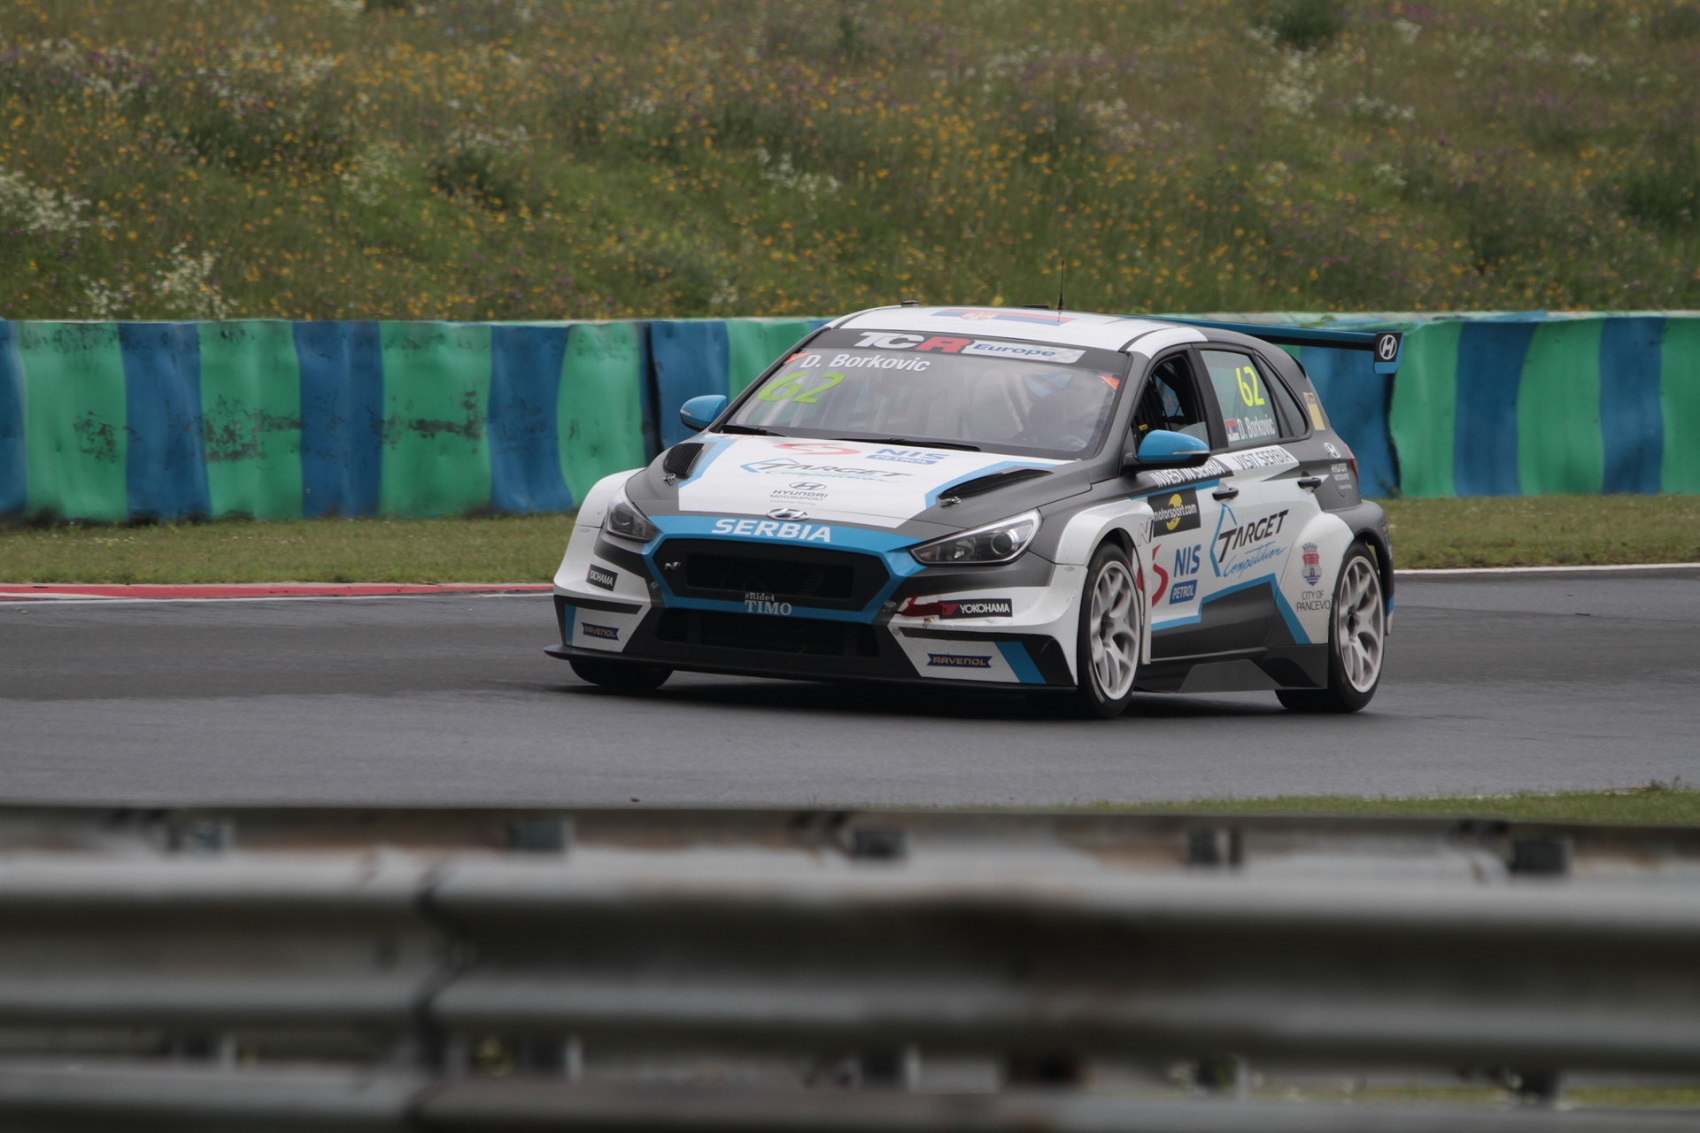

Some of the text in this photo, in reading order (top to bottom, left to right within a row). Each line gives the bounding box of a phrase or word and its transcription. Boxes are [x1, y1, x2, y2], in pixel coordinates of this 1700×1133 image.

[854, 332, 1056, 357] TCR Europe
[800, 353, 931, 372] D. Borkovic
[756, 371, 845, 403] 62
[1236, 366, 1265, 407] 62
[1237, 418, 1249, 440] D.
[876, 449, 950, 459] NIS
[1232, 448, 1293, 470] VISIT SERBIA
[758, 463, 914, 476] TARGET
[1149, 469, 1184, 488] INVEST
[1180, 468, 1197, 481] IN
[1153, 503, 1198, 521] motorsport.com
[712, 519, 831, 543] SERBIA
[1218, 509, 1289, 563] TARGET
[1173, 544, 1202, 578] NIS
[1223, 541, 1288, 578] Competition
[745, 592, 775, 601] #Ride4
[1172, 584, 1195, 600] PETROL
[1302, 589, 1324, 601] CITY OF
[744, 600, 792, 616] TIMO
[960, 603, 1010, 614] YOKOHAMA
[1296, 600, 1331, 612] PANCEVO
[932, 655, 987, 666] RAVENOL
